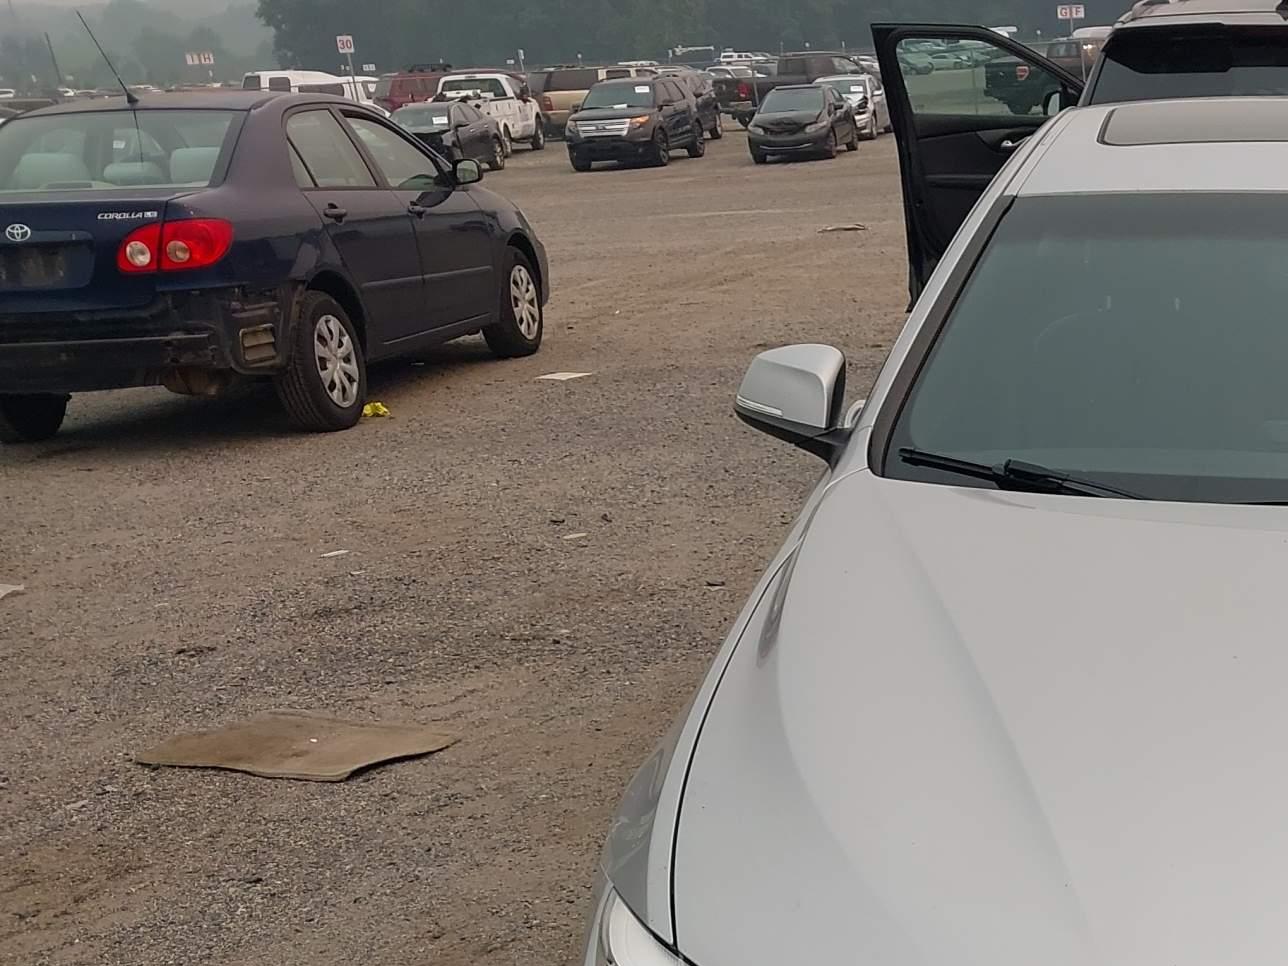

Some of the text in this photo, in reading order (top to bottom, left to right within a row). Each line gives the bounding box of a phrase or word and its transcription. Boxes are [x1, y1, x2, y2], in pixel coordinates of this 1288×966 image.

[1060, 7, 1081, 17] G F
[339, 39, 352, 49] 30
[97, 211, 143, 220] COROLLA
